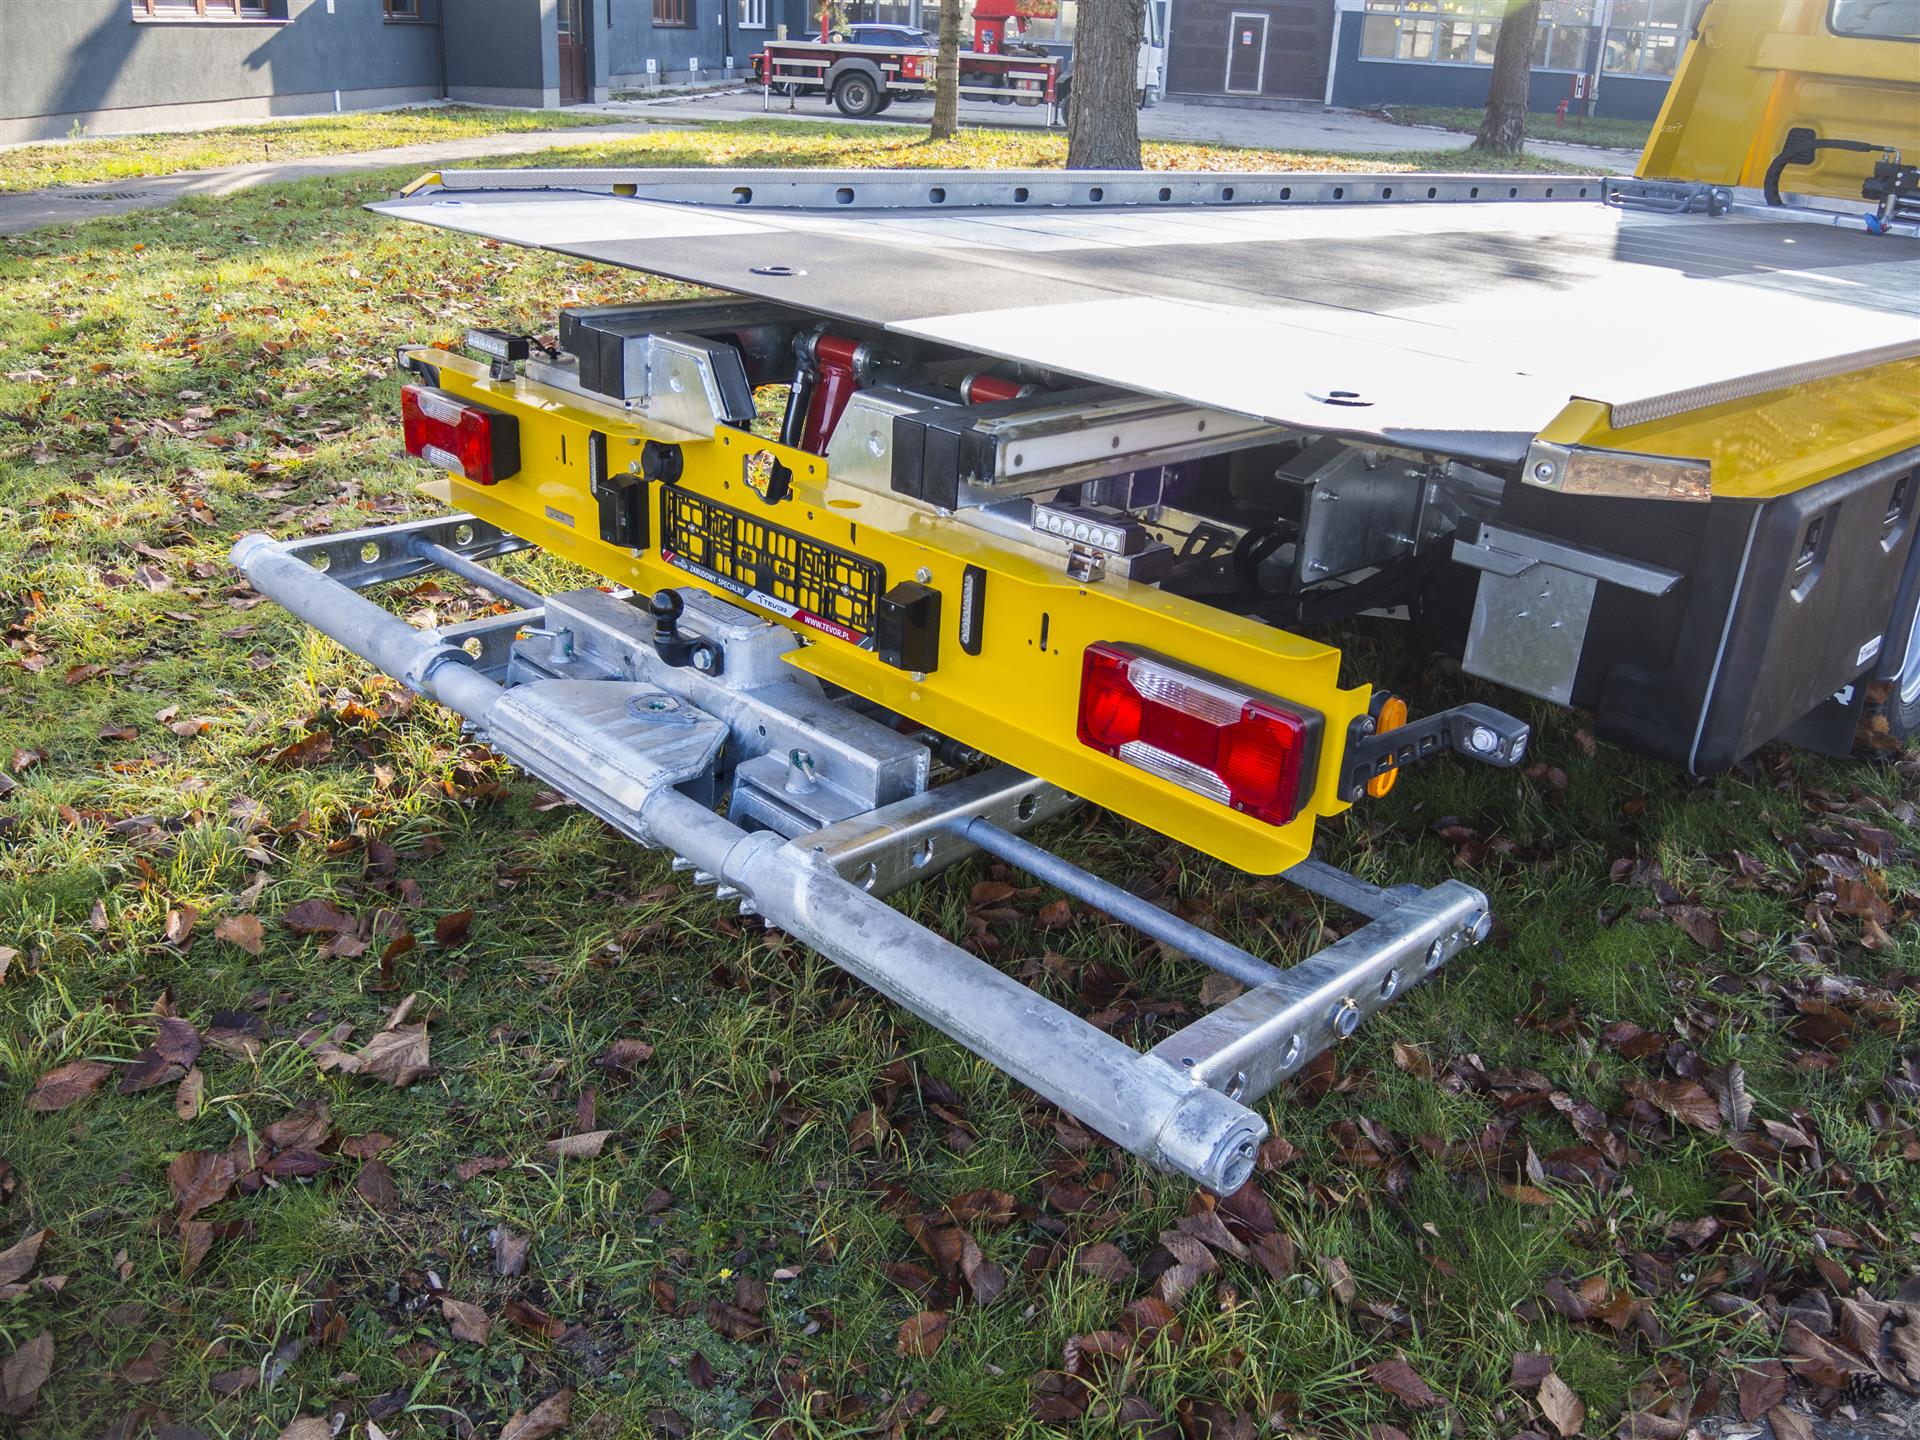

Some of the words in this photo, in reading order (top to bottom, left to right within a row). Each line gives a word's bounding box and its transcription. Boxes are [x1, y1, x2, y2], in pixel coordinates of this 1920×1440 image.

[690, 565, 716, 582] ZABUDOWY
[763, 600, 787, 613] TEVOR
[804, 615, 850, 641] WWW.TEVOR.PL
